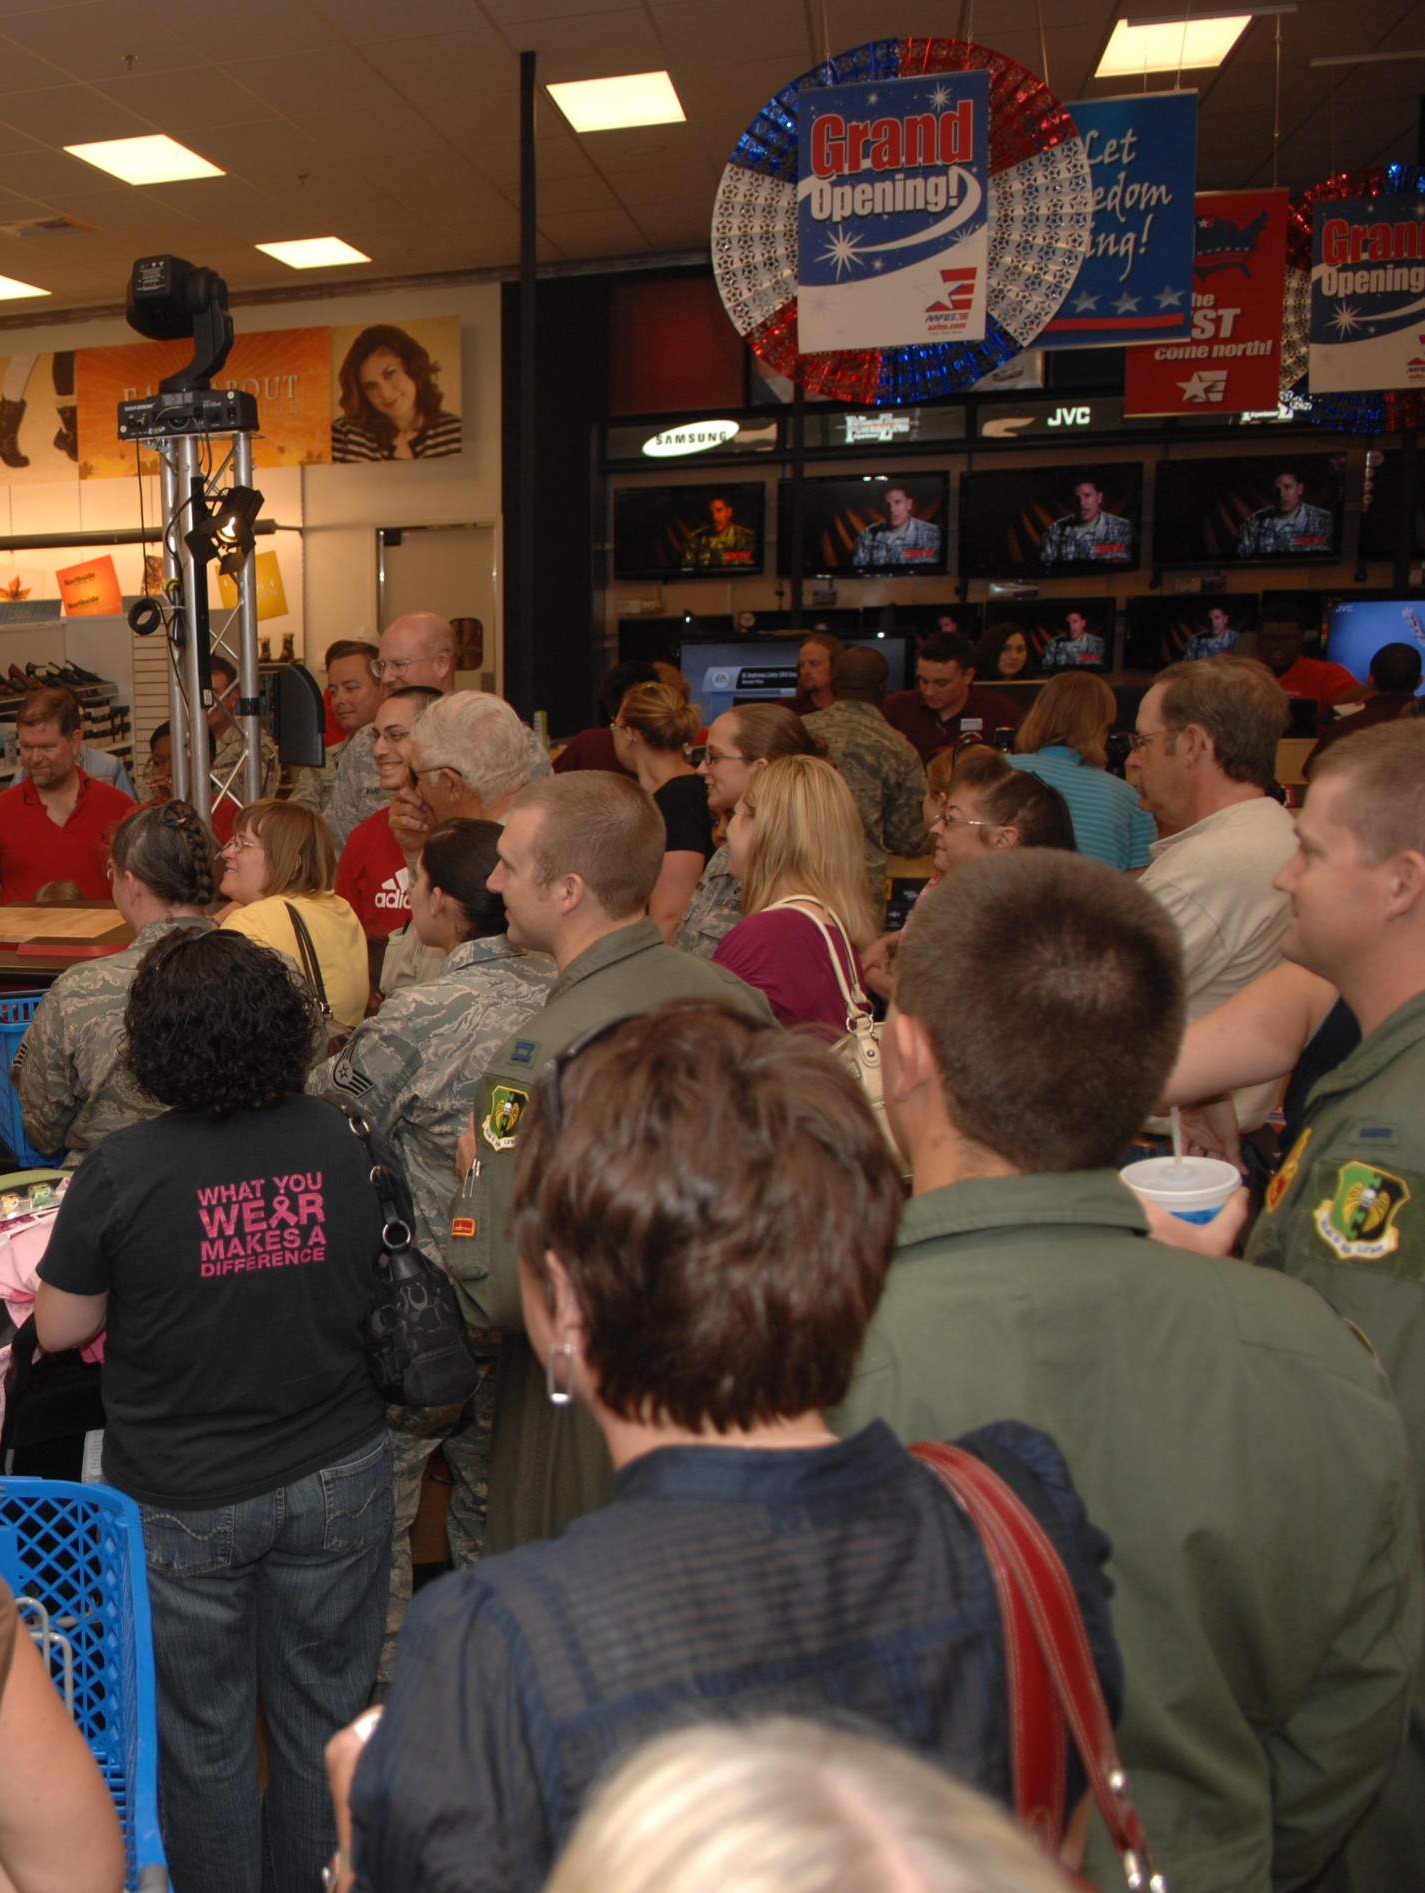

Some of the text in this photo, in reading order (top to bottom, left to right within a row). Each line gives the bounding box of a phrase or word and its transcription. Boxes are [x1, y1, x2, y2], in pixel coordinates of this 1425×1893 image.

[811, 99, 973, 179] Grand
[1085, 128, 1137, 165] Let
[811, 166, 959, 222] Opening!
[1093, 171, 1172, 222] edom
[1085, 213, 1153, 282] ing!
[1322, 218, 1425, 266] Gran
[1191, 293, 1215, 308] he
[1190, 308, 1241, 340] ST
[1154, 339, 1273, 361] come north!
[1047, 407, 1090, 427] JVC
[655, 431, 727, 446] SAMSUNG
[375, 889, 411, 909] adi
[197, 1171, 322, 1207] WHAT YOU
[200, 1224, 327, 1261] MAKES A
[200, 1246, 326, 1278] DIFFERENCE
